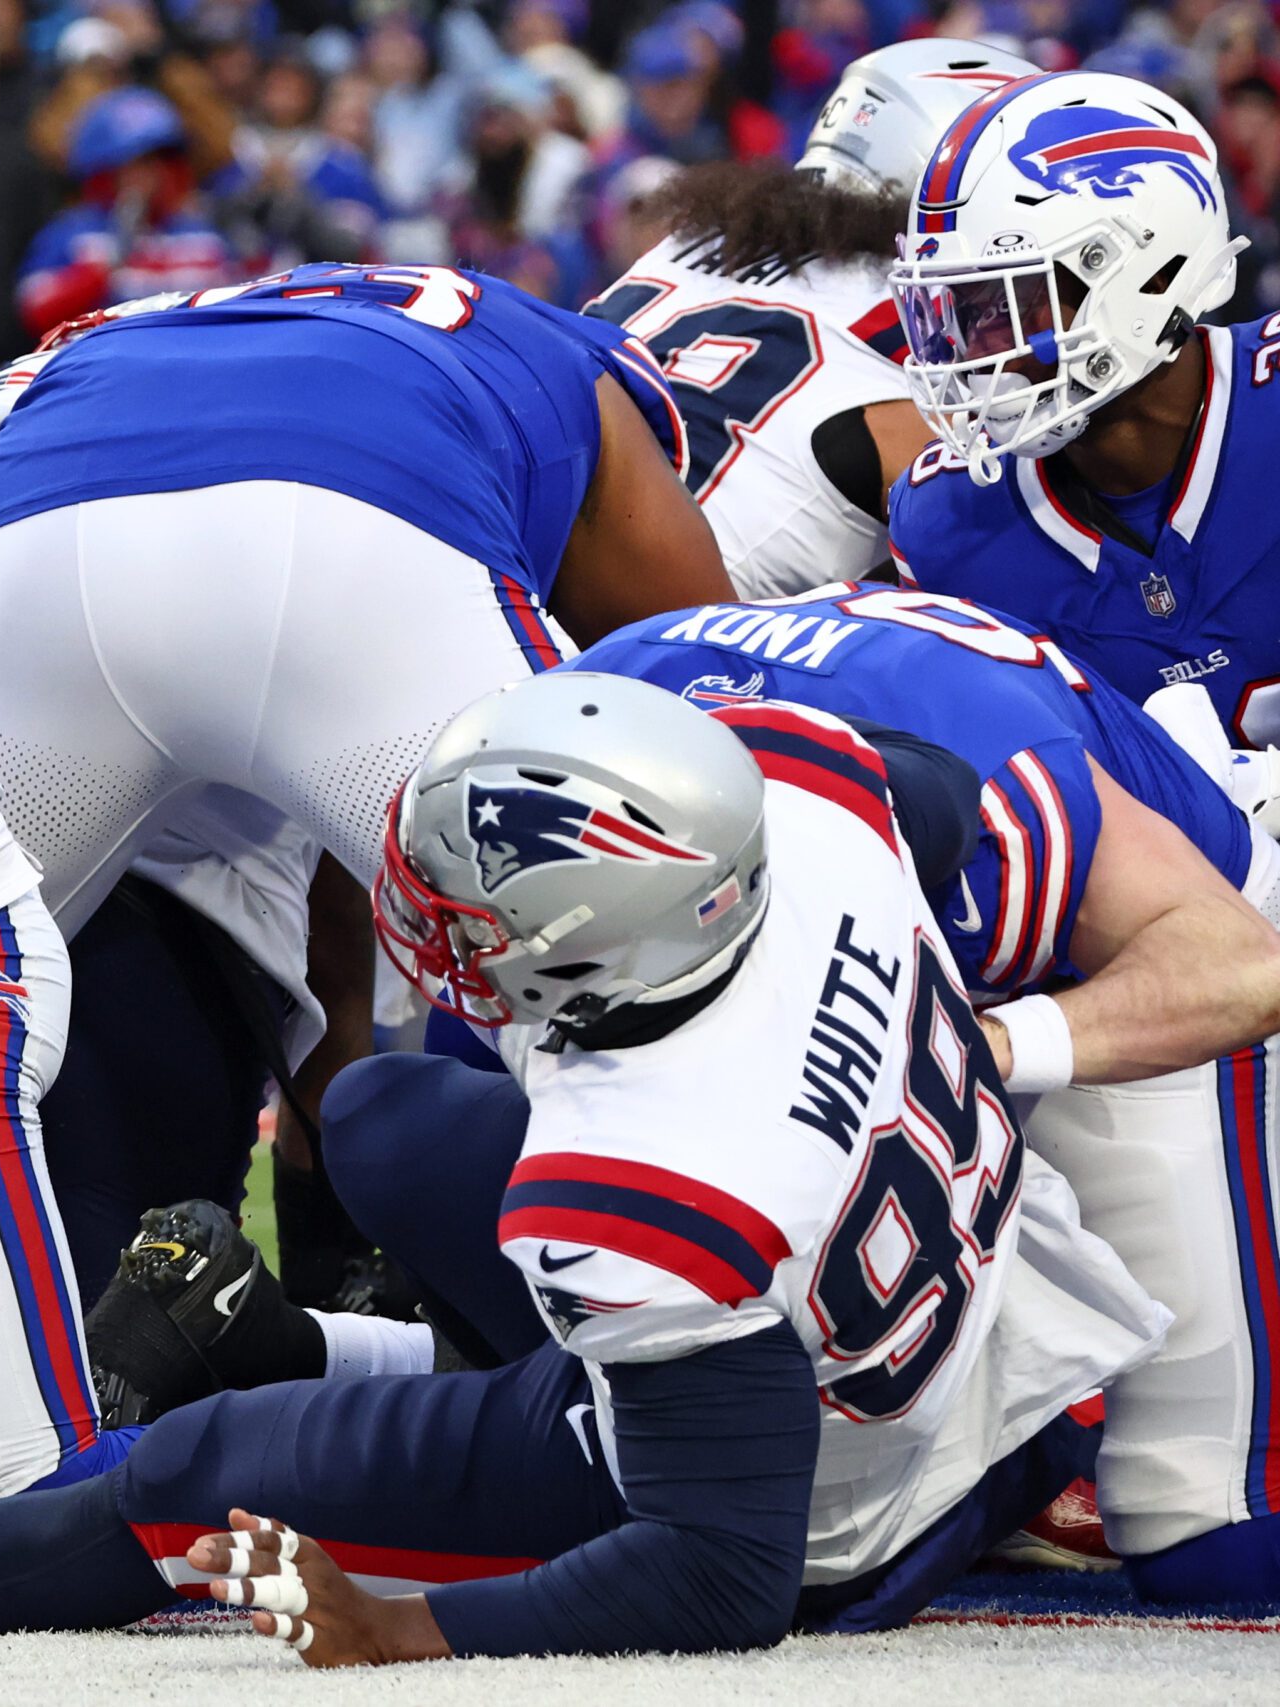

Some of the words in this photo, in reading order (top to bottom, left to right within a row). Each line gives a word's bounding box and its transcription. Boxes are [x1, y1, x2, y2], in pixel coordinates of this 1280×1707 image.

[986, 243, 1034, 257] OAKLEY
[1146, 591, 1172, 613] NFL
[660, 604, 865, 670] KNOX
[1157, 648, 1231, 686] BILLS
[788, 913, 902, 1154] WHITE
[807, 924, 1025, 1425] 99
